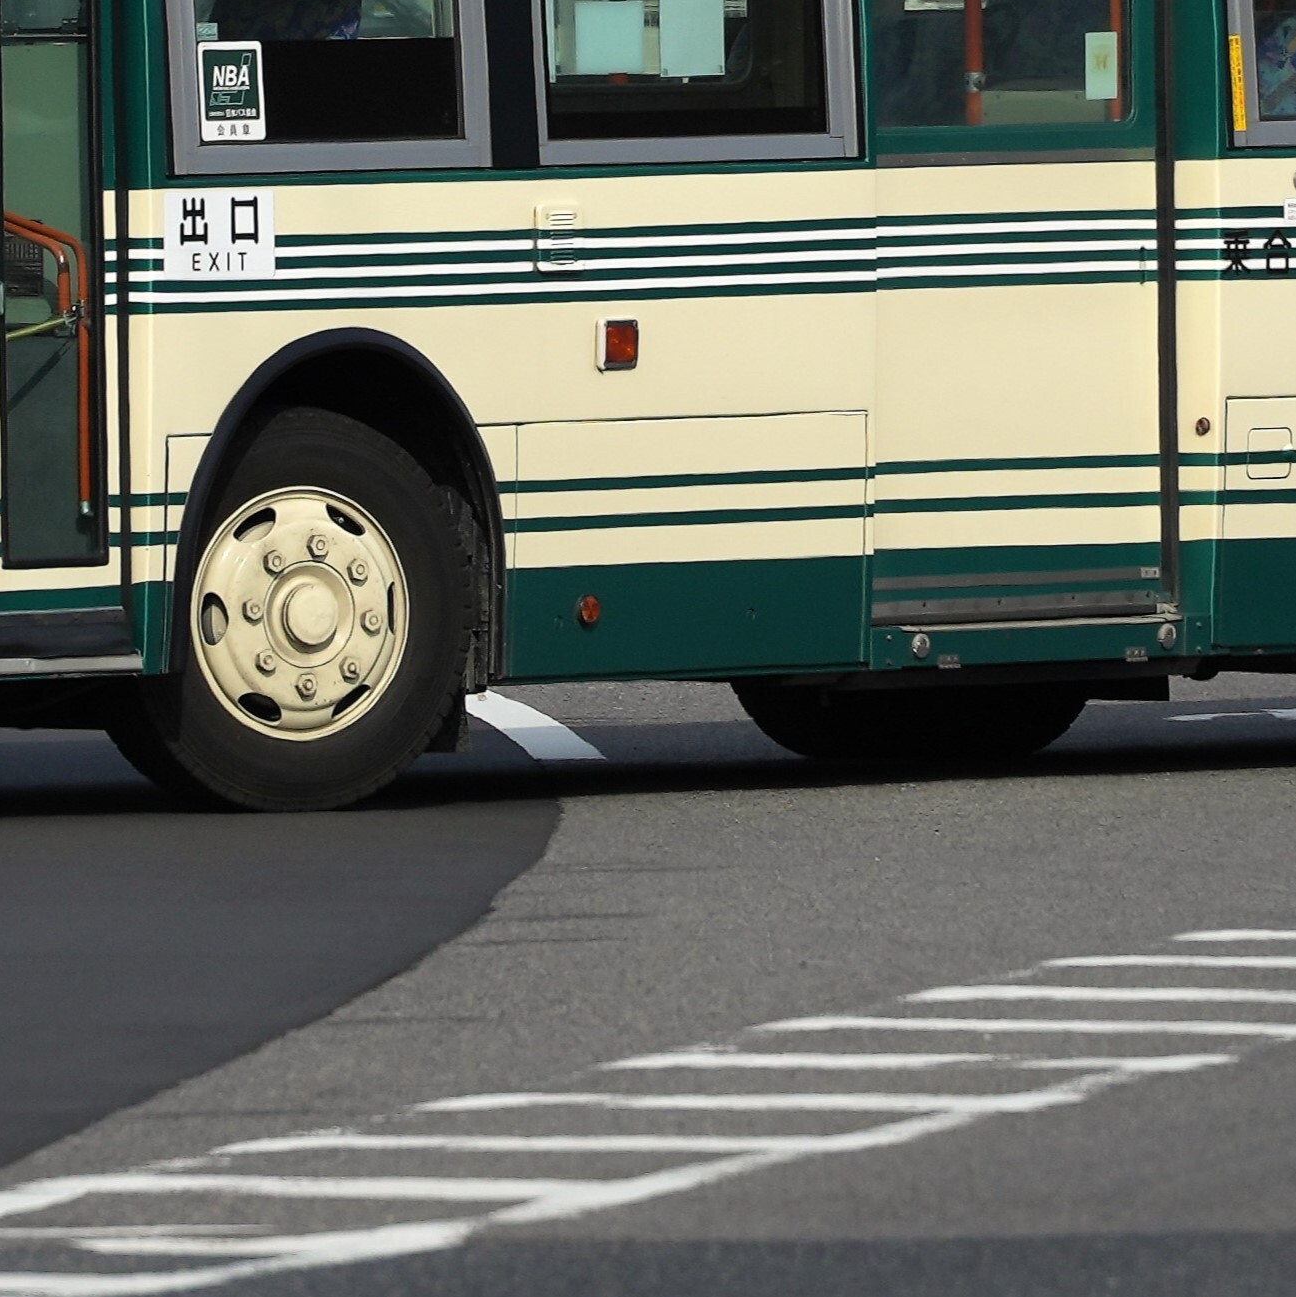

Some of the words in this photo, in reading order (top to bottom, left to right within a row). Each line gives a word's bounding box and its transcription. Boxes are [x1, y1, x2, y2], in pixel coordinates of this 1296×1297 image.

[212, 64, 251, 87] NBA
[179, 195, 260, 246] 出口
[191, 251, 249, 272] EXIT
[1222, 229, 1292, 275] 乗合
